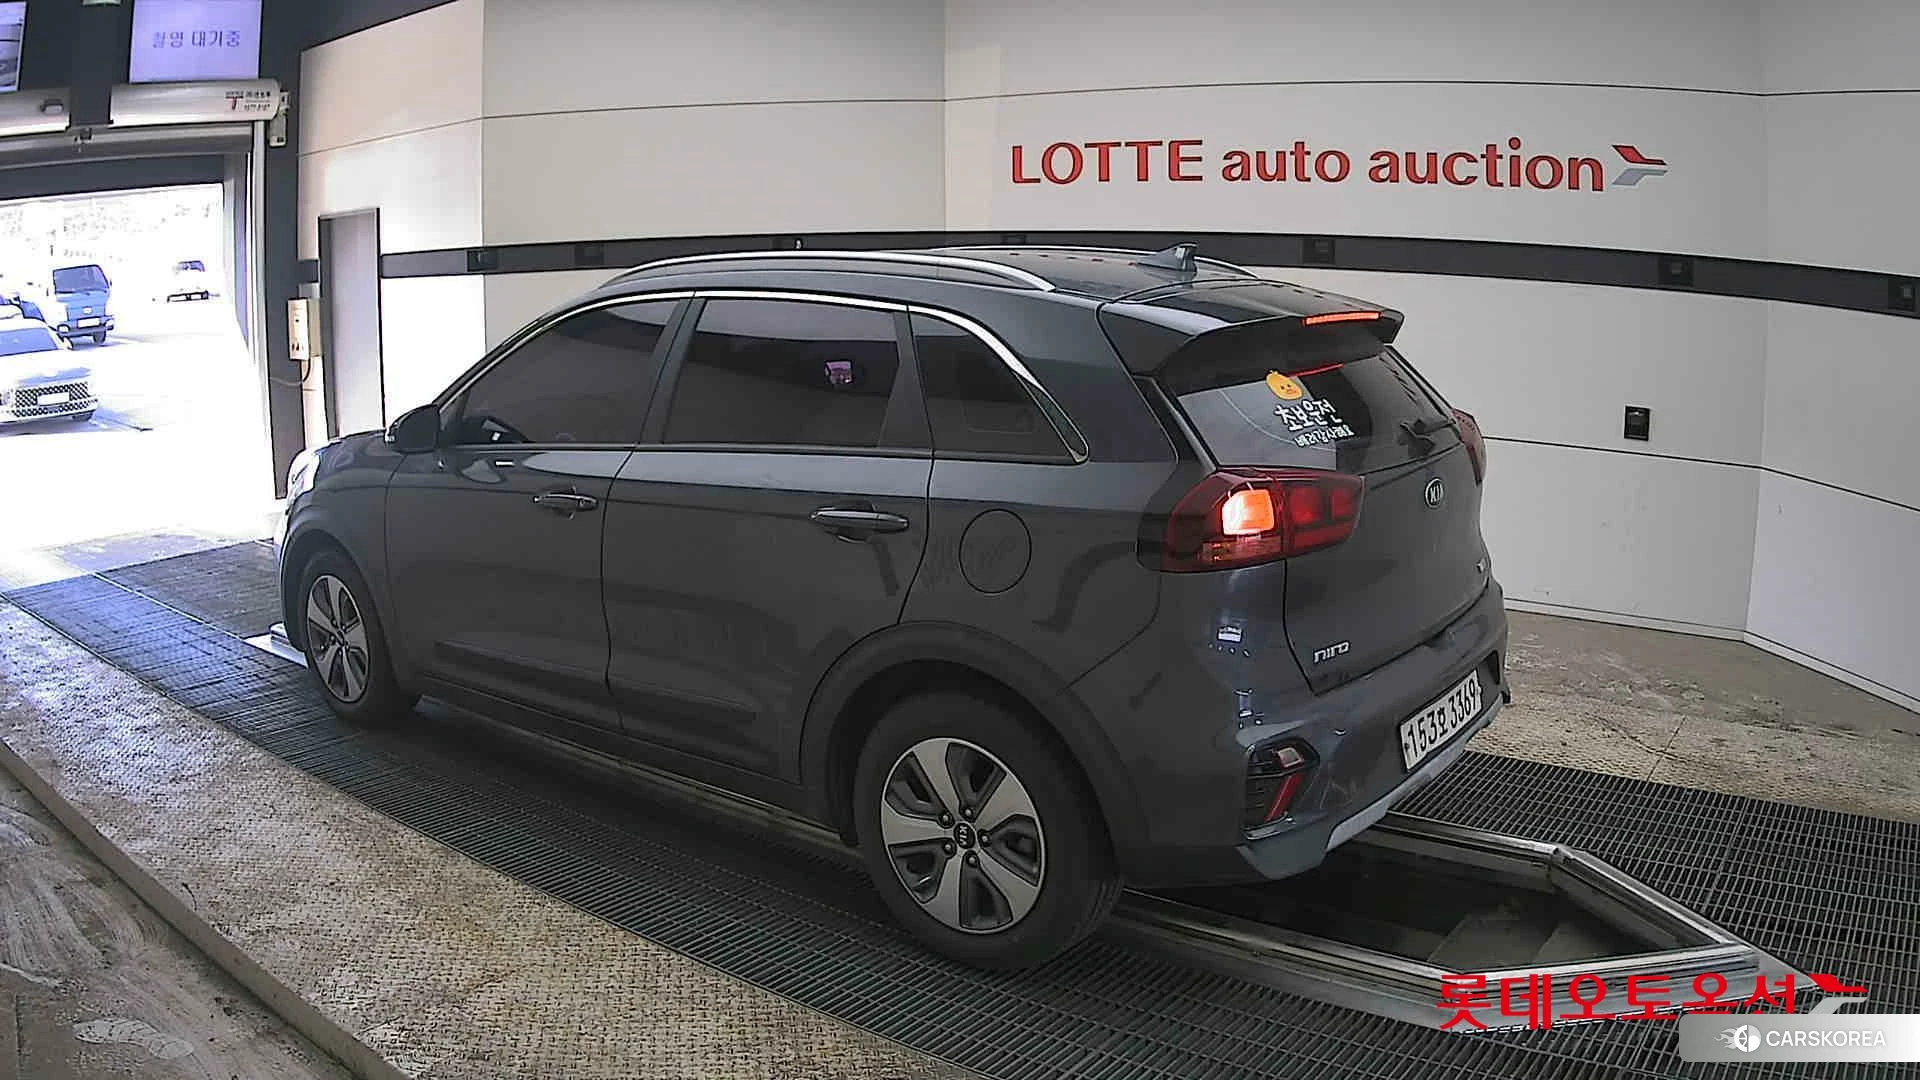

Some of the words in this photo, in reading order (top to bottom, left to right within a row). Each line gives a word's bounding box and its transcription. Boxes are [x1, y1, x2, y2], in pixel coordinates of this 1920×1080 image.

[192, 30, 241, 48] 대기중
[1010, 139, 1203, 186] LOTTE
[1221, 140, 1351, 183] auto
[1368, 136, 1605, 192] auction
[1274, 398, 1343, 431] 초보운전
[1448, 678, 1476, 729] 3369
